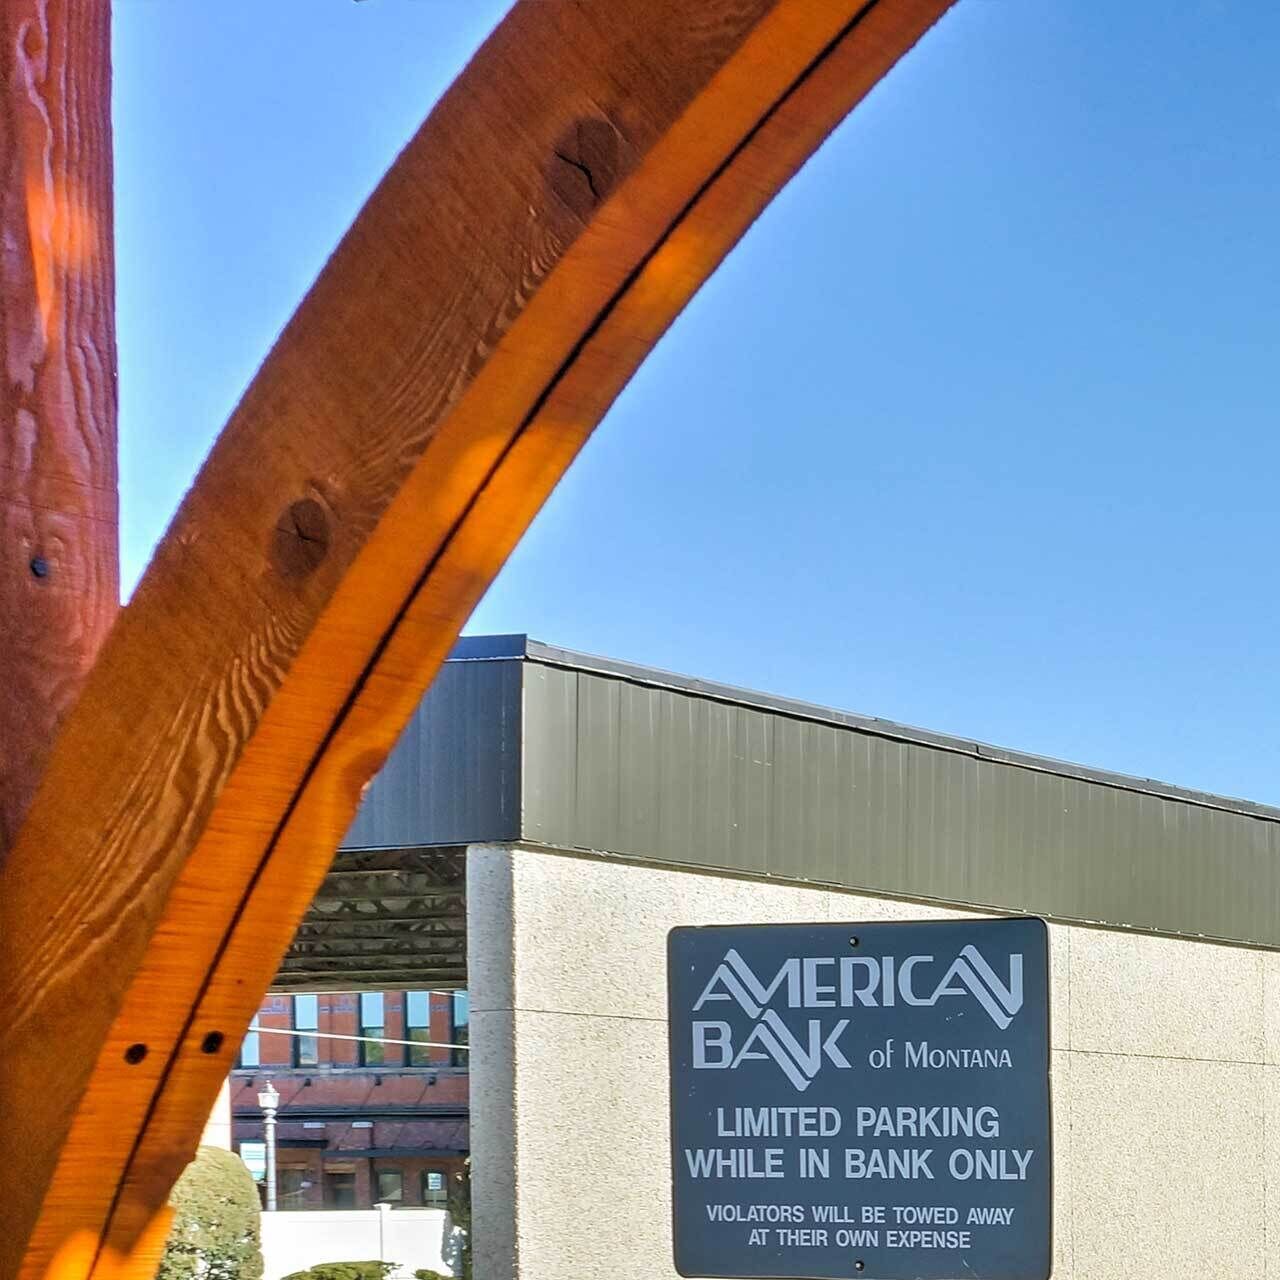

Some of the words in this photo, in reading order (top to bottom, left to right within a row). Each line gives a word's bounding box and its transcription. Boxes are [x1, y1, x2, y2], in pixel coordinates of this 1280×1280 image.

[691, 943, 1024, 1031] AMERICAN
[692, 1008, 852, 1092] BANK
[869, 1038, 894, 1069] of
[717, 1106, 842, 1138] LIMITED
[857, 1106, 1000, 1138] PARKING
[685, 1149, 784, 1178] WHILE
[800, 1150, 830, 1179] IN
[845, 1149, 935, 1180] BANK
[949, 1149, 1034, 1181] ONLY
[706, 1205, 805, 1223] VIOLATORS
[811, 1206, 854, 1223] WILL
[862, 1206, 886, 1224] BE
[893, 1207, 959, 1225] TOWED
[965, 1208, 1015, 1226] AWAY
[748, 1230, 771, 1246] AT
[776, 1230, 829, 1247] THEIR
[836, 1230, 879, 1248] OWN
[886, 1231, 971, 1249] EXPENSE
